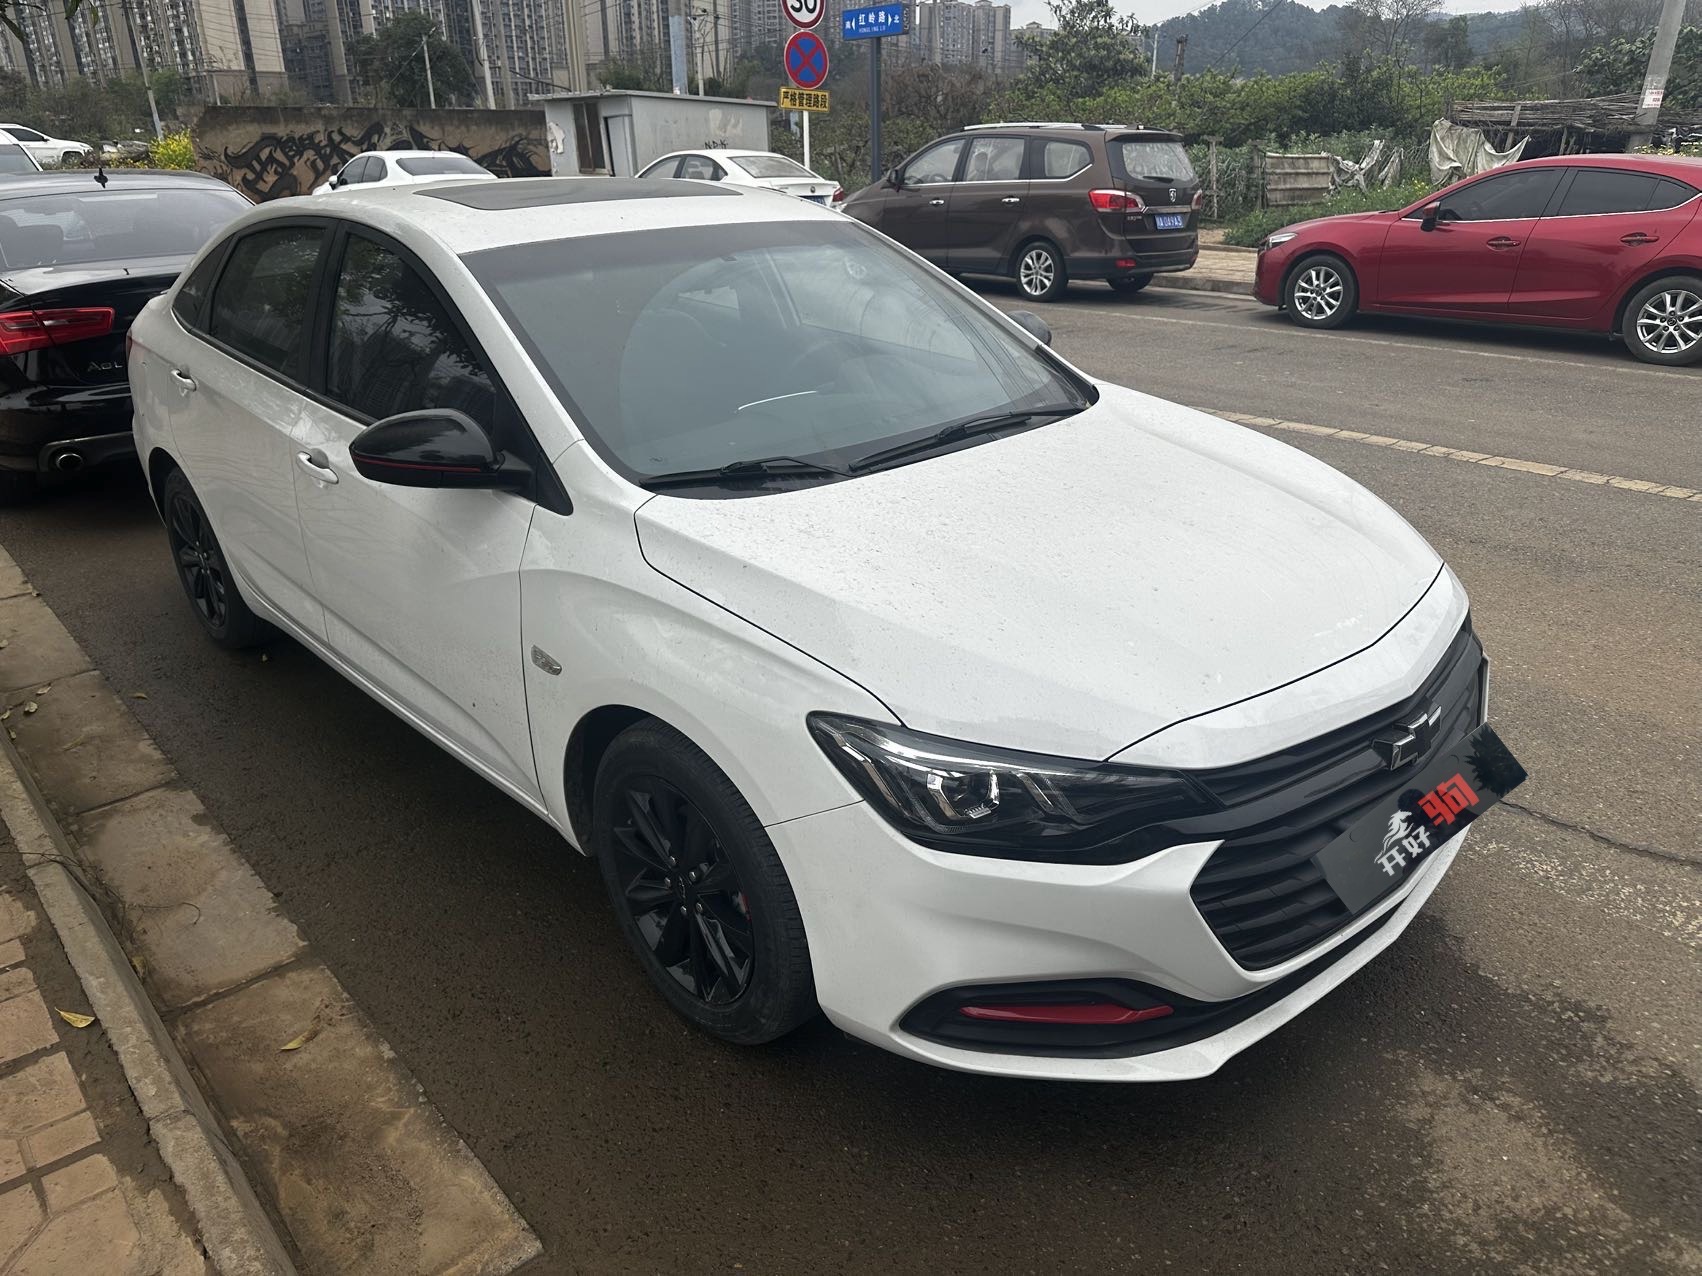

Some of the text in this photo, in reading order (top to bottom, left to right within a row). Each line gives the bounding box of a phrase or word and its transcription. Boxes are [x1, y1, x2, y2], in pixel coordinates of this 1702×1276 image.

[858, 10, 886, 25] 红岭路
[781, 91, 828, 109] 严格管理路段
